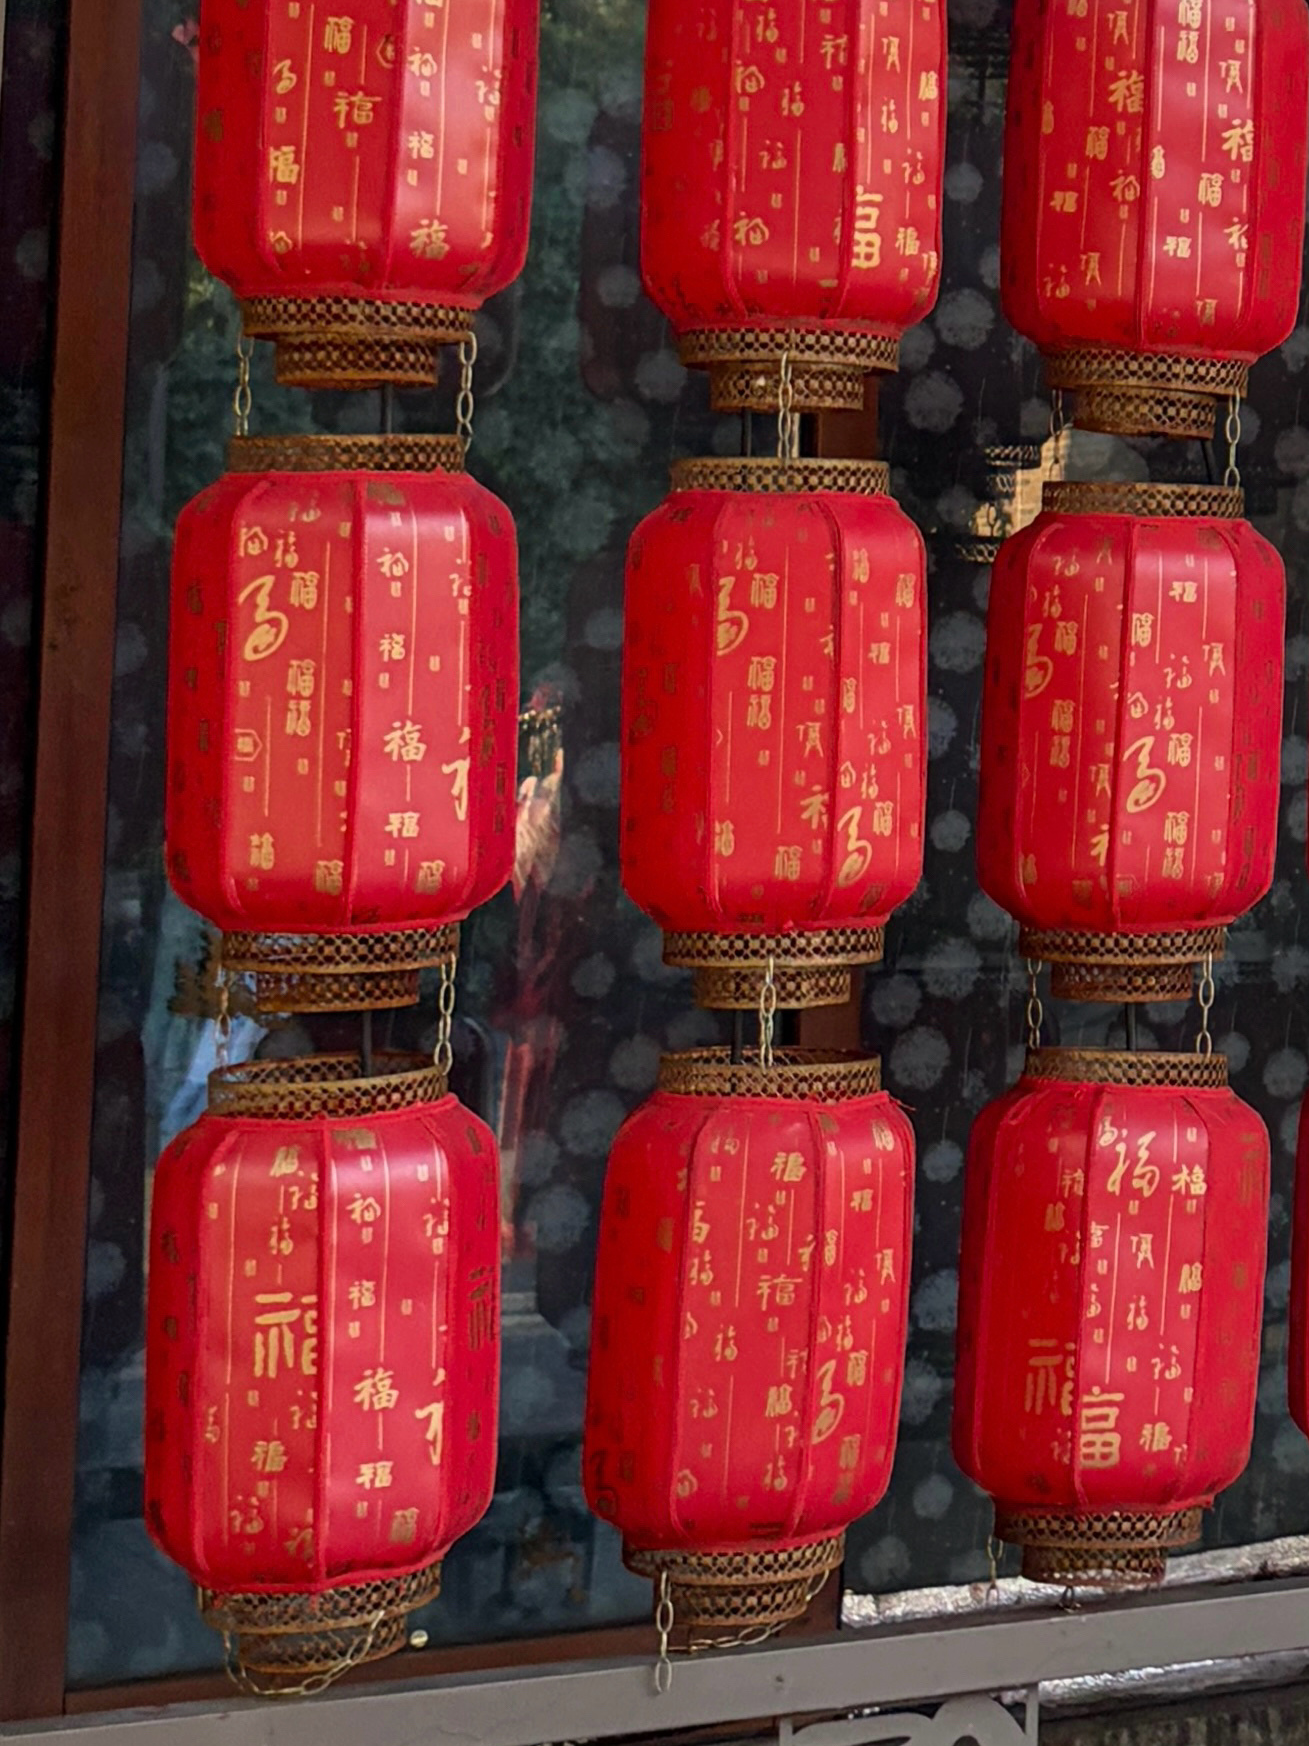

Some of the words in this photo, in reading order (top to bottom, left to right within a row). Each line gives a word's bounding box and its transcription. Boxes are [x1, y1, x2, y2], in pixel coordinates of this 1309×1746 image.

[324, 16, 350, 54] 福
[335, 92, 379, 129] 福
[290, 572, 318, 609] 福
[380, 633, 405, 662] 福
[384, 721, 427, 760] 福
[385, 812, 419, 838] 福
[1108, 1129, 1160, 1194] 福
[1172, 1164, 1207, 1195] 福
[348, 1280, 376, 1310] 福
[354, 1369, 399, 1410] 福
[356, 1462, 392, 1490] 福
